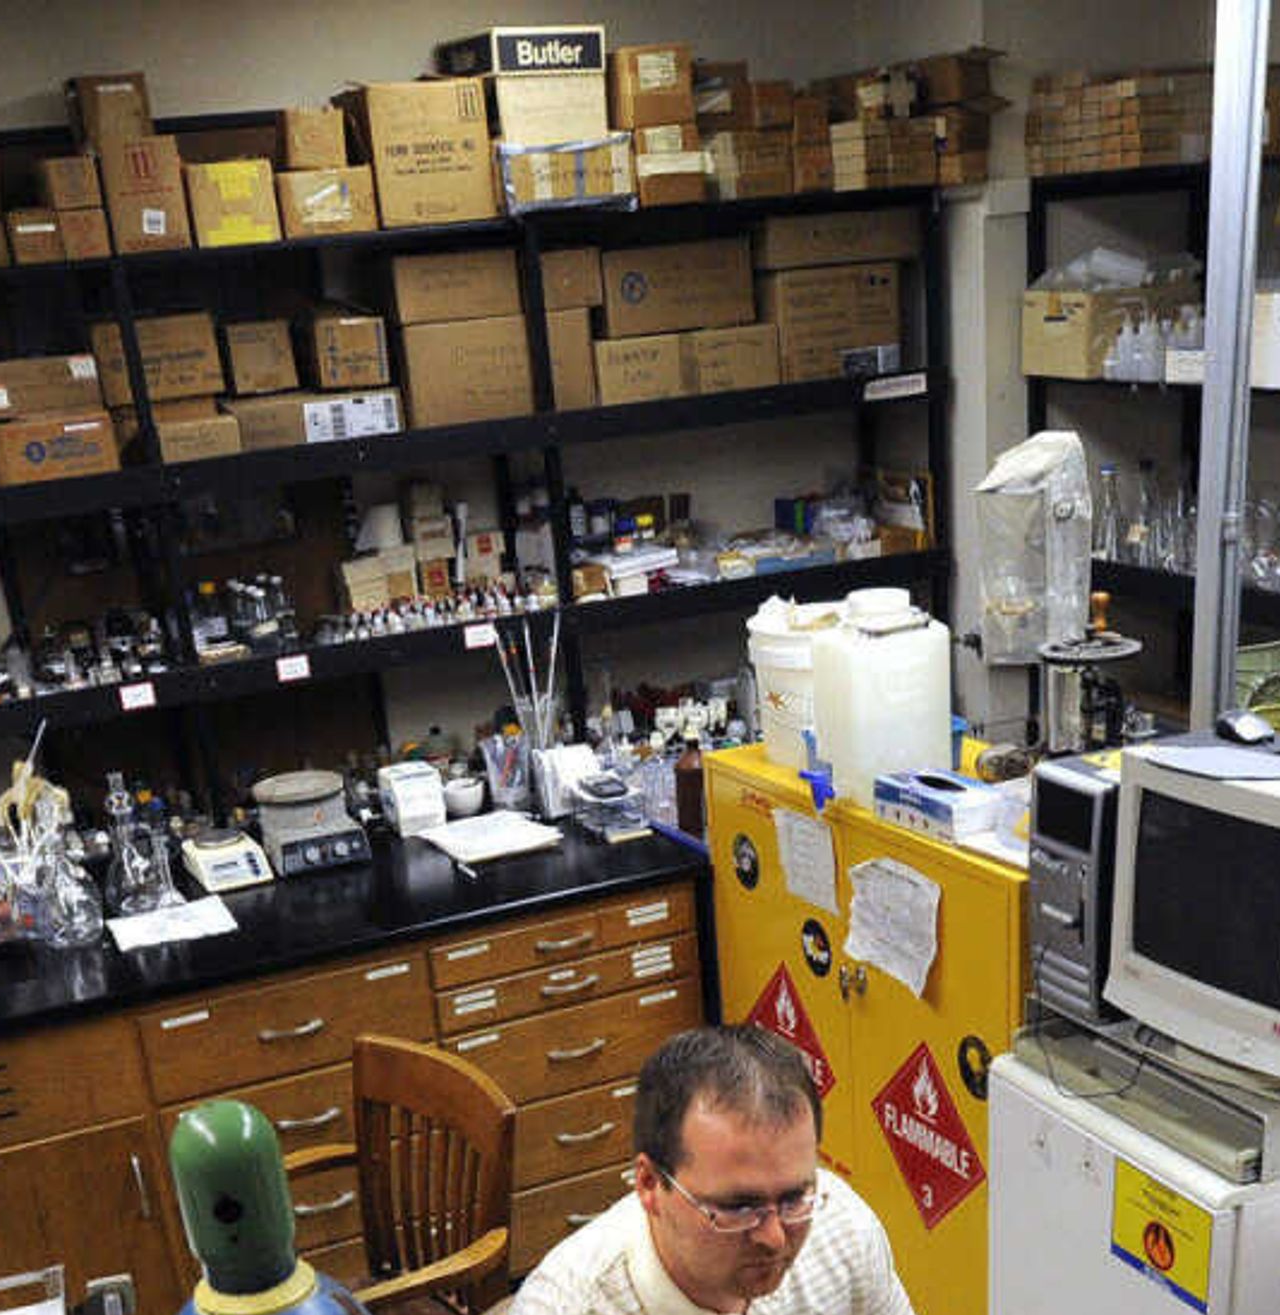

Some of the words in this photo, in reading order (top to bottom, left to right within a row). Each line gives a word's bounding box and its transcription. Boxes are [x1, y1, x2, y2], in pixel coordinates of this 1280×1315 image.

[516, 39, 584, 66] Butler
[884, 1103, 971, 1180] FLAMMABLE
[922, 1183, 933, 1209] 3
